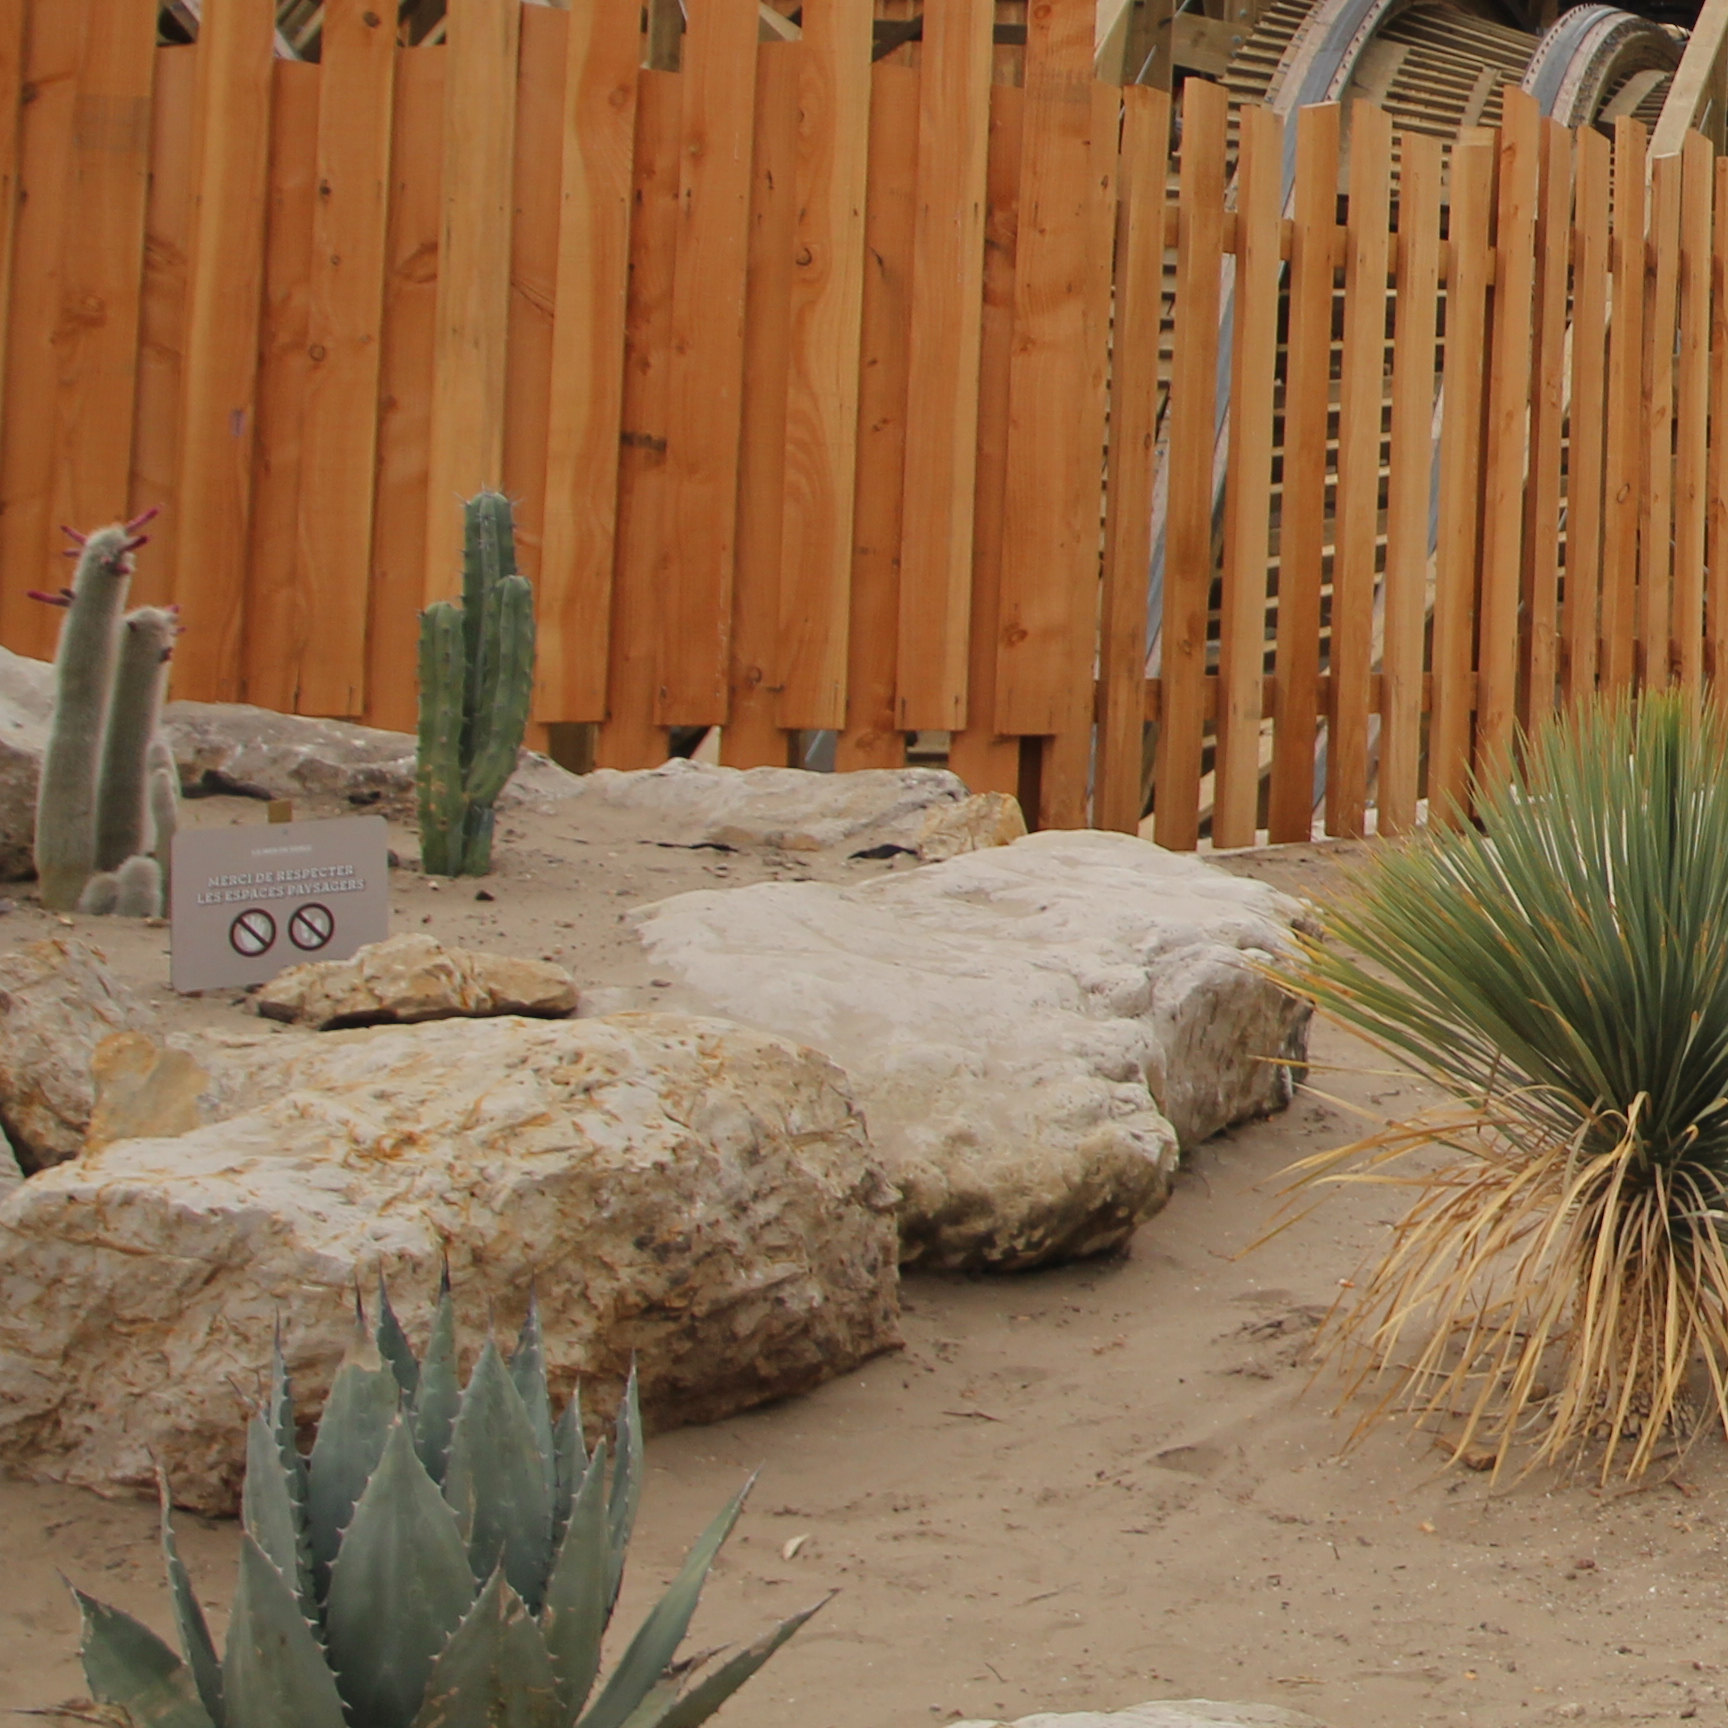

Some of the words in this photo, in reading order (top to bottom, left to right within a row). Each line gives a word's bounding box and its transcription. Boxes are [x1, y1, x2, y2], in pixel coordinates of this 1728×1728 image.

[208, 874, 252, 888] MERCI
[255, 872, 273, 884] DE
[276, 864, 354, 882] RESPECTER
[197, 891, 221, 904] LES
[225, 885, 285, 902] ESPACES
[287, 879, 365, 897] PAYSAGERS
